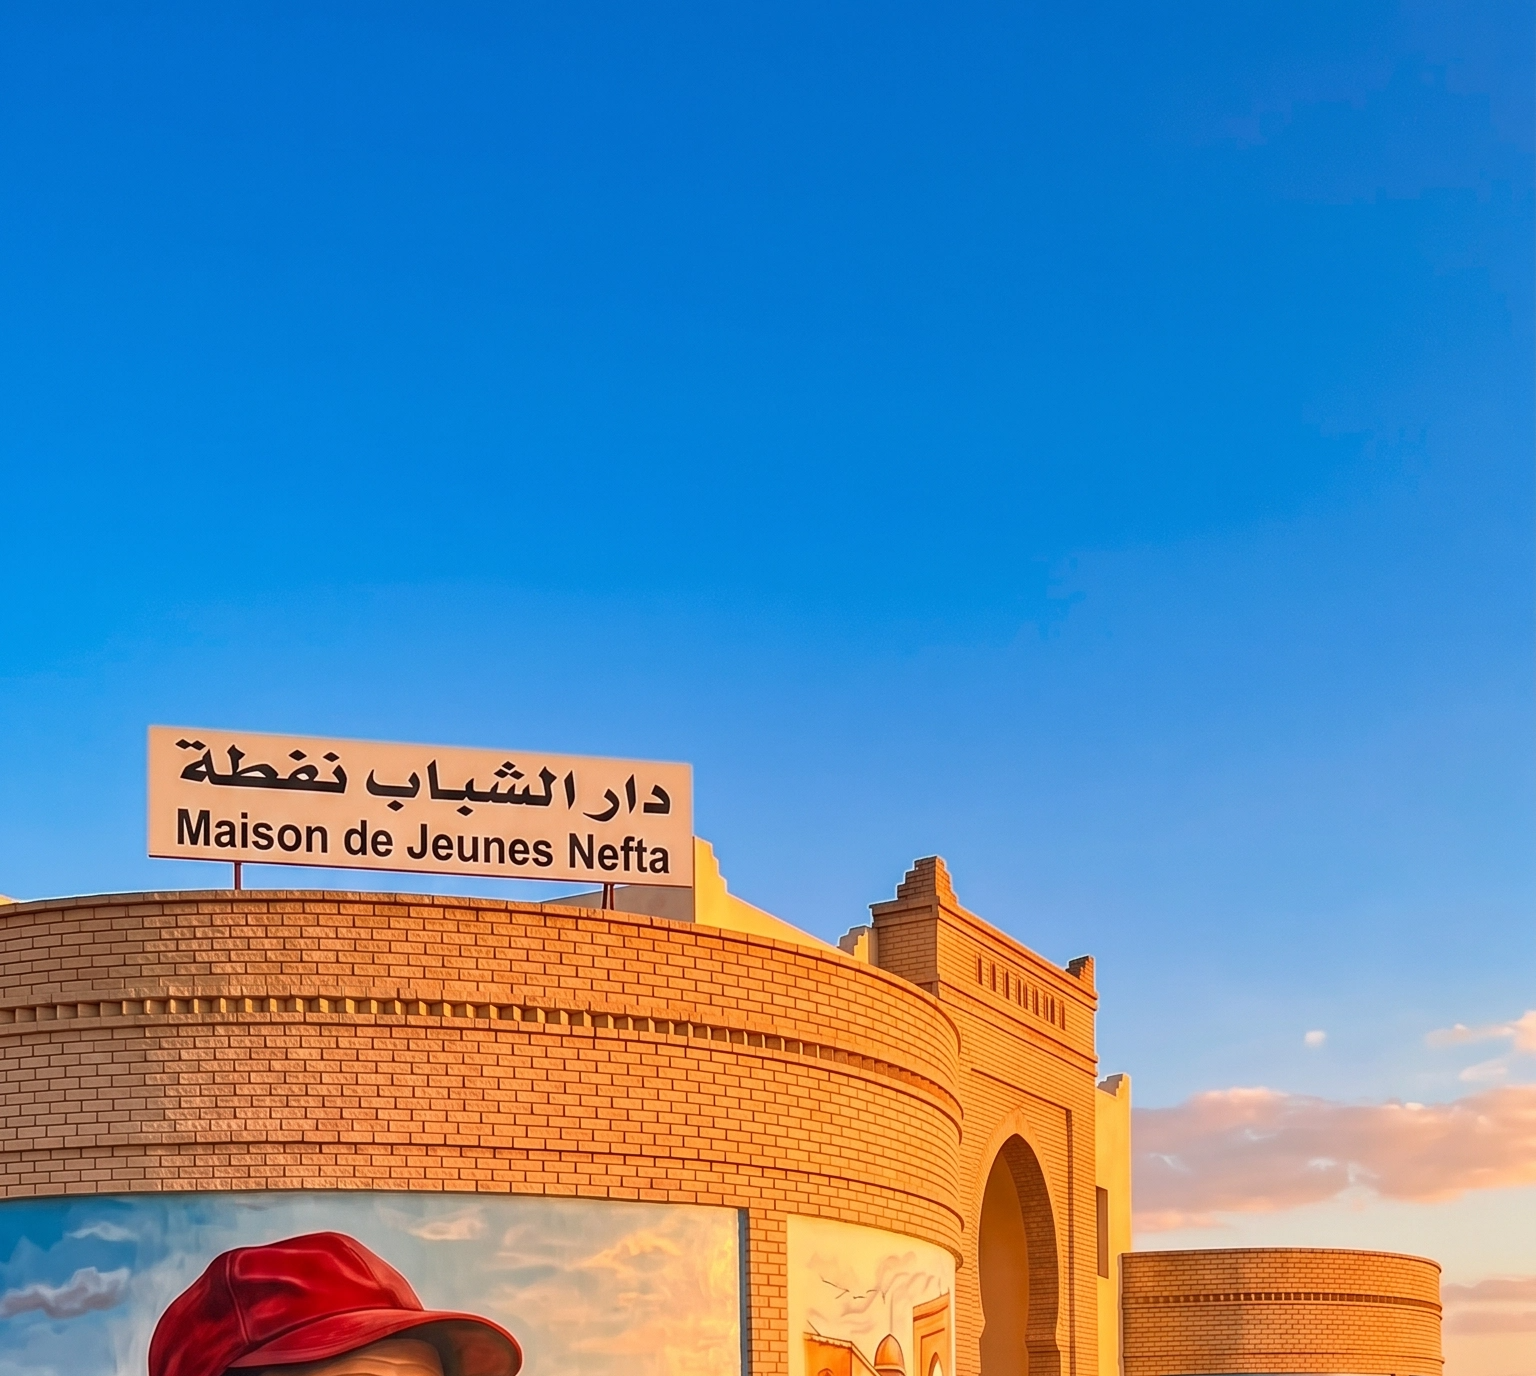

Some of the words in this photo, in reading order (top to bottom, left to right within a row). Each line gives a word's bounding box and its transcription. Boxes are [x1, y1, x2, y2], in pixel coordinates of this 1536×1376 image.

[175, 739, 348, 794] نفطة
[366, 759, 576, 817] الشباب
[583, 774, 671, 823] دار
[177, 808, 328, 854] Maison
[344, 819, 393, 857] de
[406, 823, 553, 867] Jeunes
[569, 833, 670, 874] Nefta
